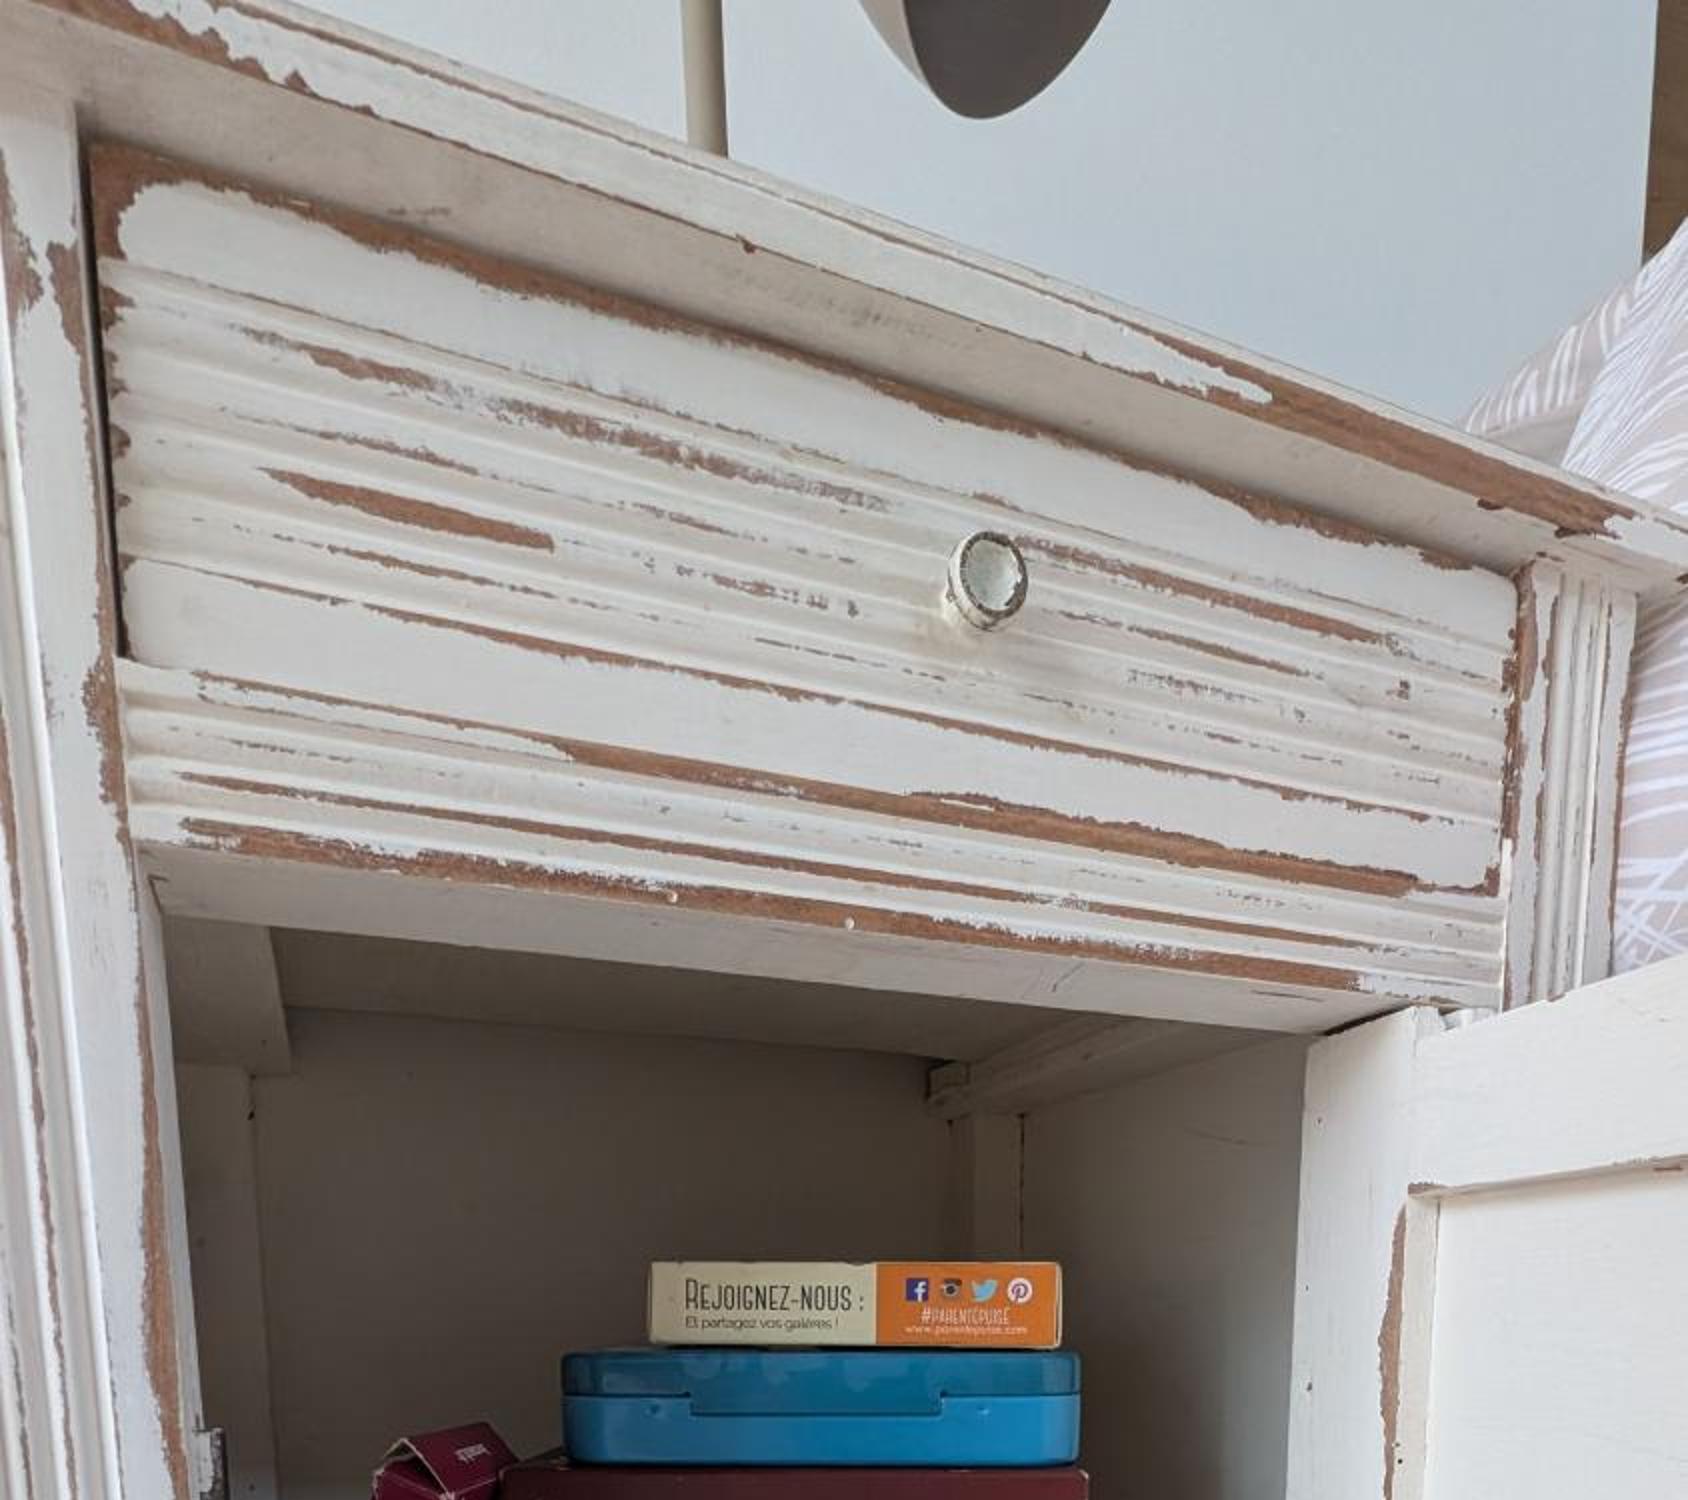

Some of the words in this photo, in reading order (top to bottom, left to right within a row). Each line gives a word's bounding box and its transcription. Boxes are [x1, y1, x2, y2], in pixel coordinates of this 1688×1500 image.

[685, 1278, 852, 1311] REJOIGNEZ-NOUS
[702, 1316, 757, 1331] partagez
[760, 1318, 783, 1329] vos
